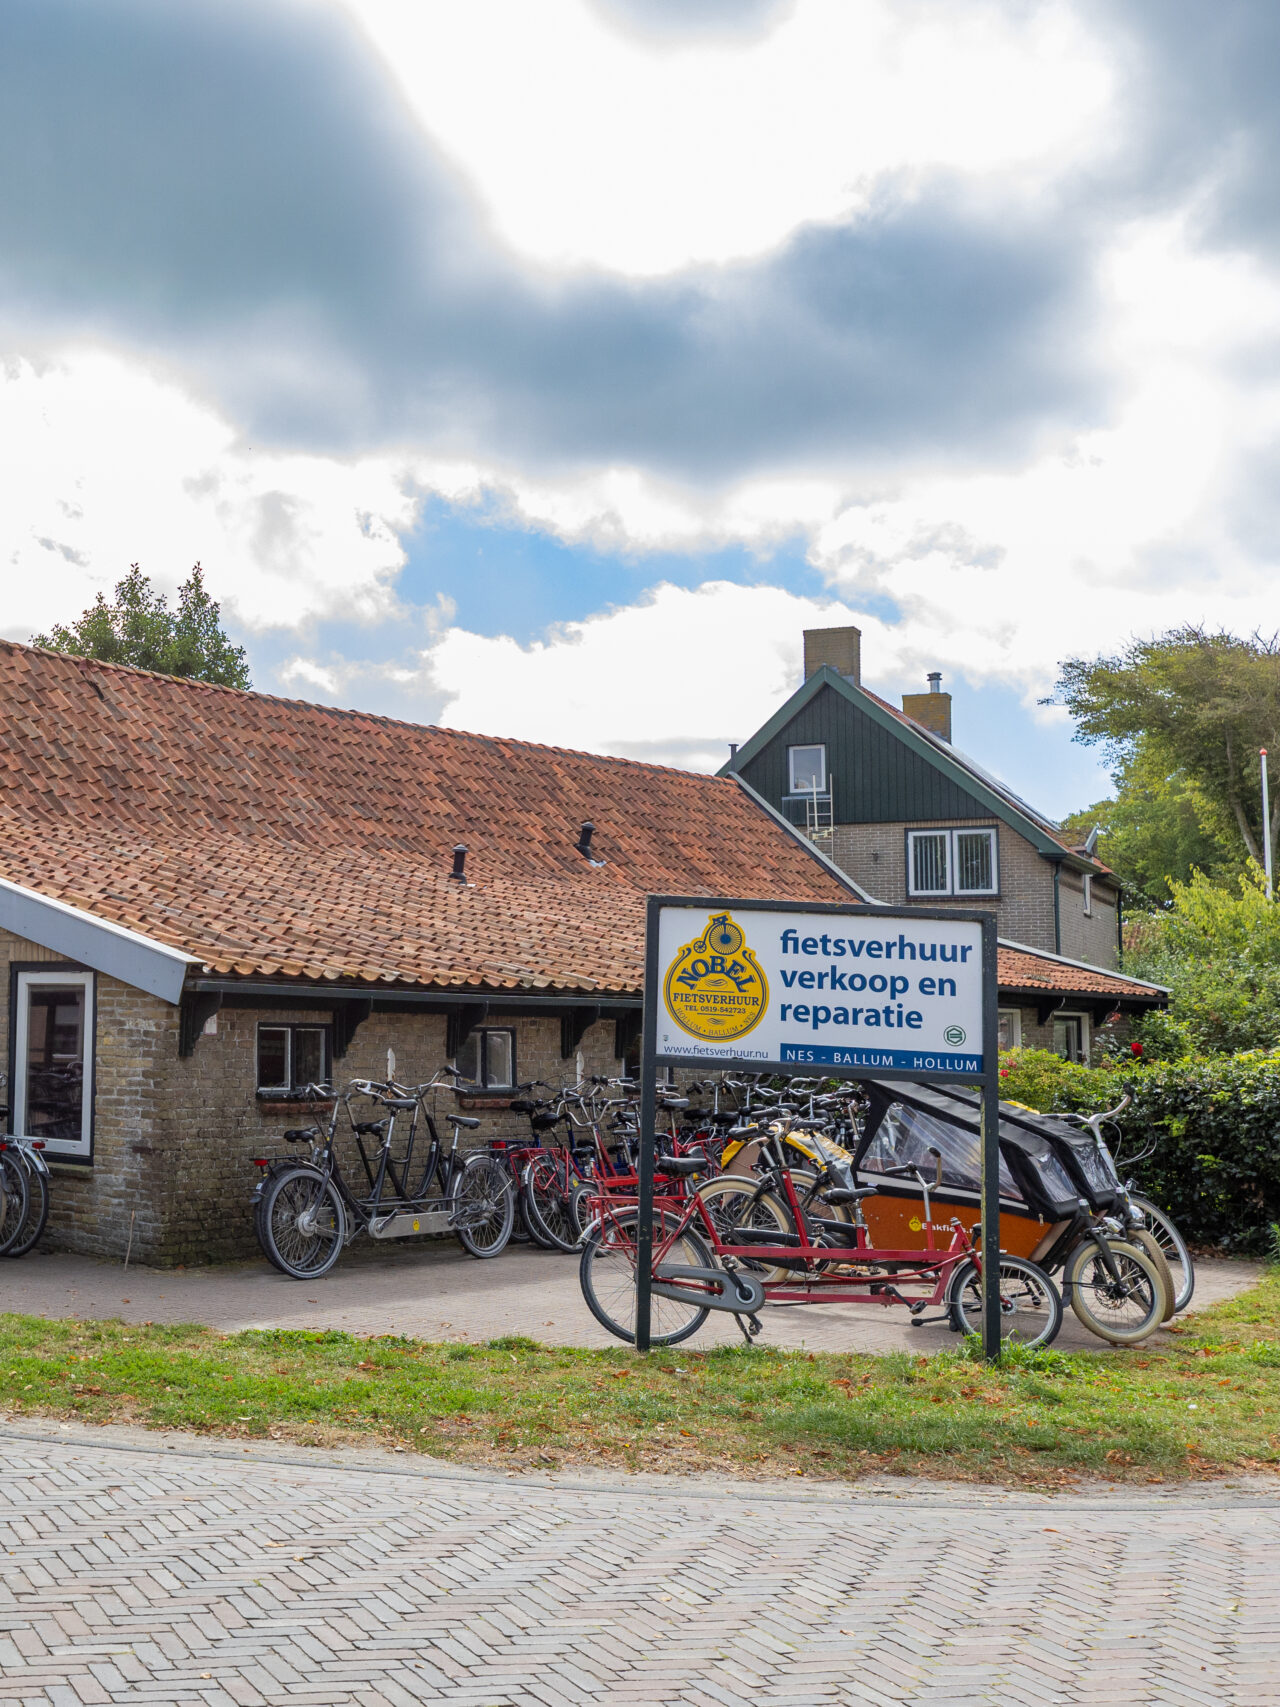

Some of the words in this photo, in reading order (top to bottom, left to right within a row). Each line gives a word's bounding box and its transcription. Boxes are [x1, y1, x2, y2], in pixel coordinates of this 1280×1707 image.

[780, 928, 973, 963] fietsverhuur
[676, 955, 757, 993] NOBEL
[780, 965, 910, 1000] verkoop
[918, 974, 957, 997] en
[673, 992, 760, 1007] FIETSVERHUUR
[700, 1005, 747, 1014] 0519-542723
[676, 1008, 701, 1031] HOLLUM
[708, 1026, 739, 1036] BALLUM
[743, 1011, 756, 1025] NES
[780, 1001, 924, 1030] reparatie
[664, 1045, 769, 1059] www.fietsverhuur.nu
[786, 1049, 814, 1062] NES
[833, 1052, 894, 1067] BALLUM
[913, 1057, 978, 1072] HOLLUM
